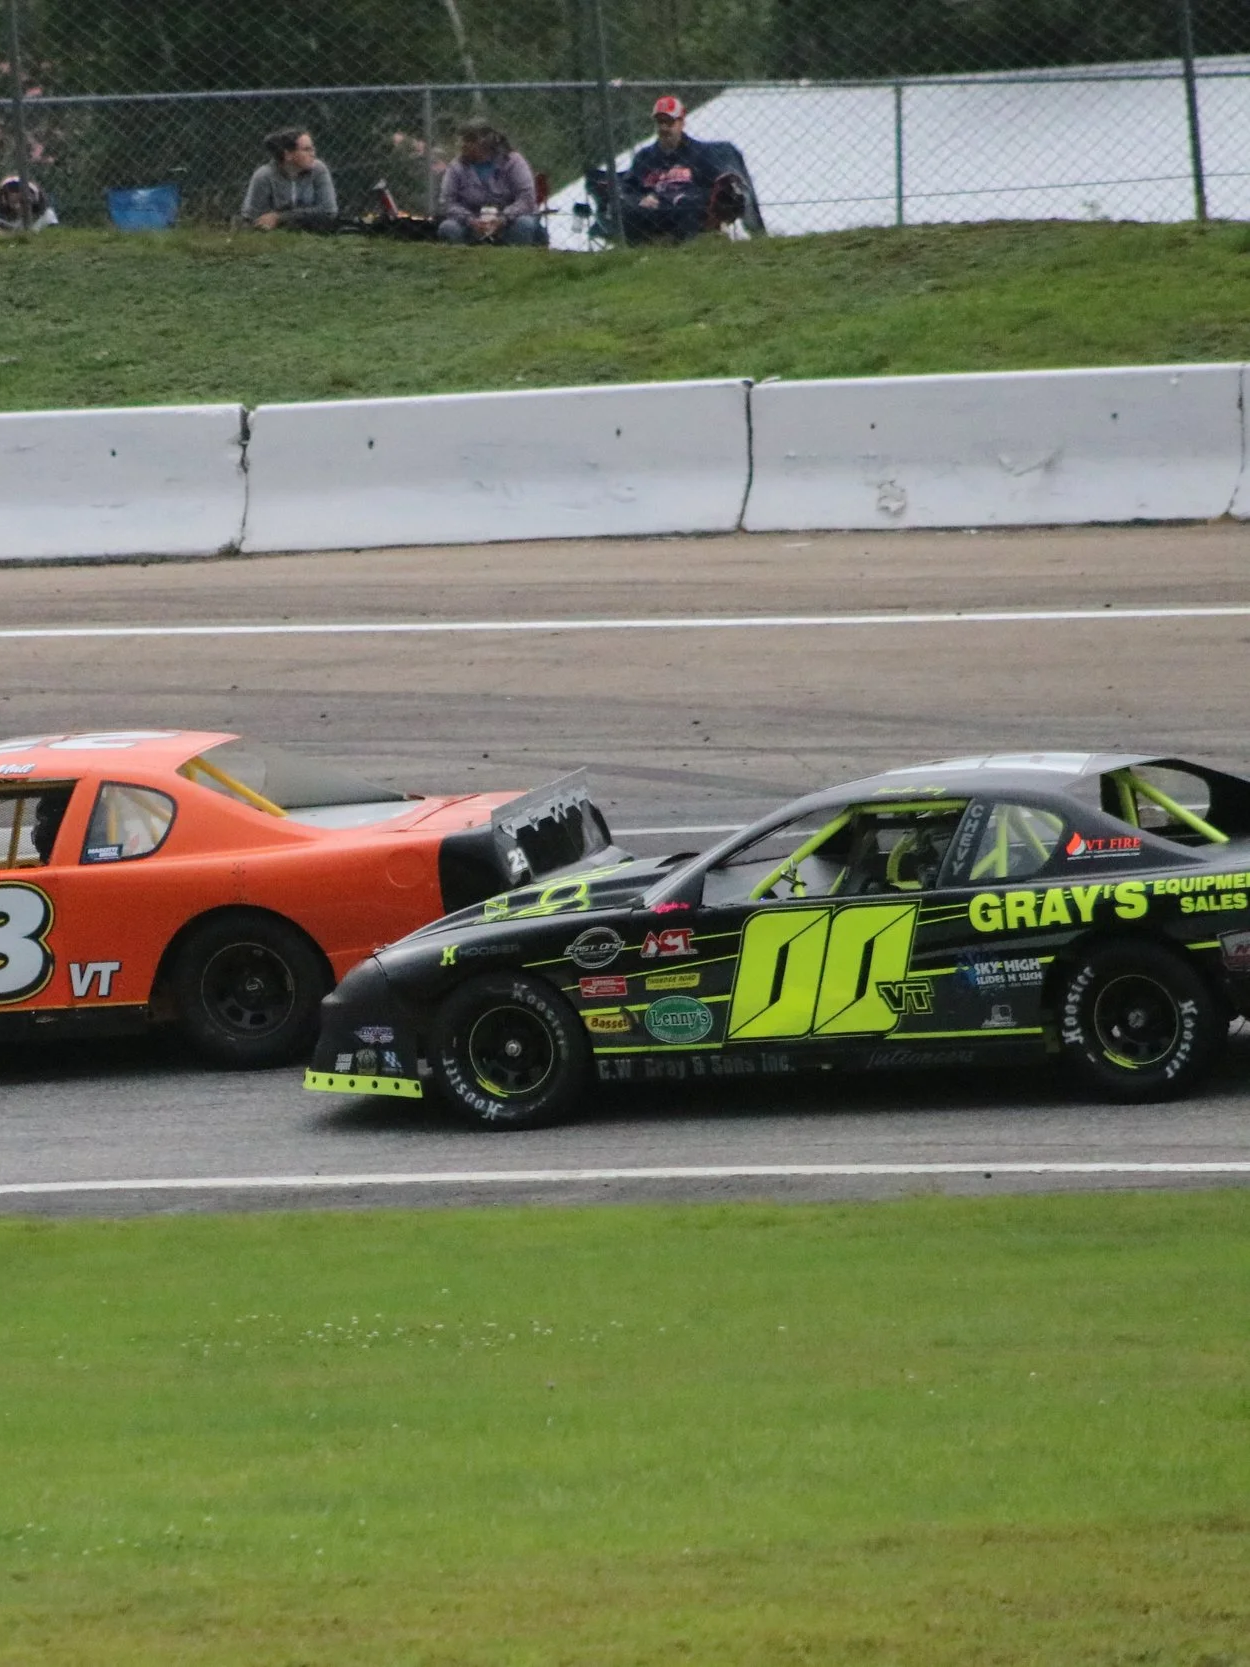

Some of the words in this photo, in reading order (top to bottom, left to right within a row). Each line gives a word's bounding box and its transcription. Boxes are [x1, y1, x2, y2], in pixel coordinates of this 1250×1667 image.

[953, 803, 983, 876] CHEVY
[1085, 839, 1105, 851] VT
[1110, 837, 1142, 850] FIRE
[969, 881, 1149, 932] GRAY'S
[1180, 892, 1248, 914] SALES
[641, 928, 696, 956] ACT
[68, 961, 121, 997] VT
[725, 899, 922, 1043] 00
[973, 961, 999, 976] SKY
[1003, 957, 1042, 973] HIGH
[975, 973, 1005, 986] SLIDES
[1018, 970, 1043, 983] SUCH
[876, 977, 935, 1016] VT
[1062, 966, 1095, 1045] Hoosier
[651, 1009, 709, 1030] Lenny's
[1165, 1000, 1198, 1079] Hoosier
